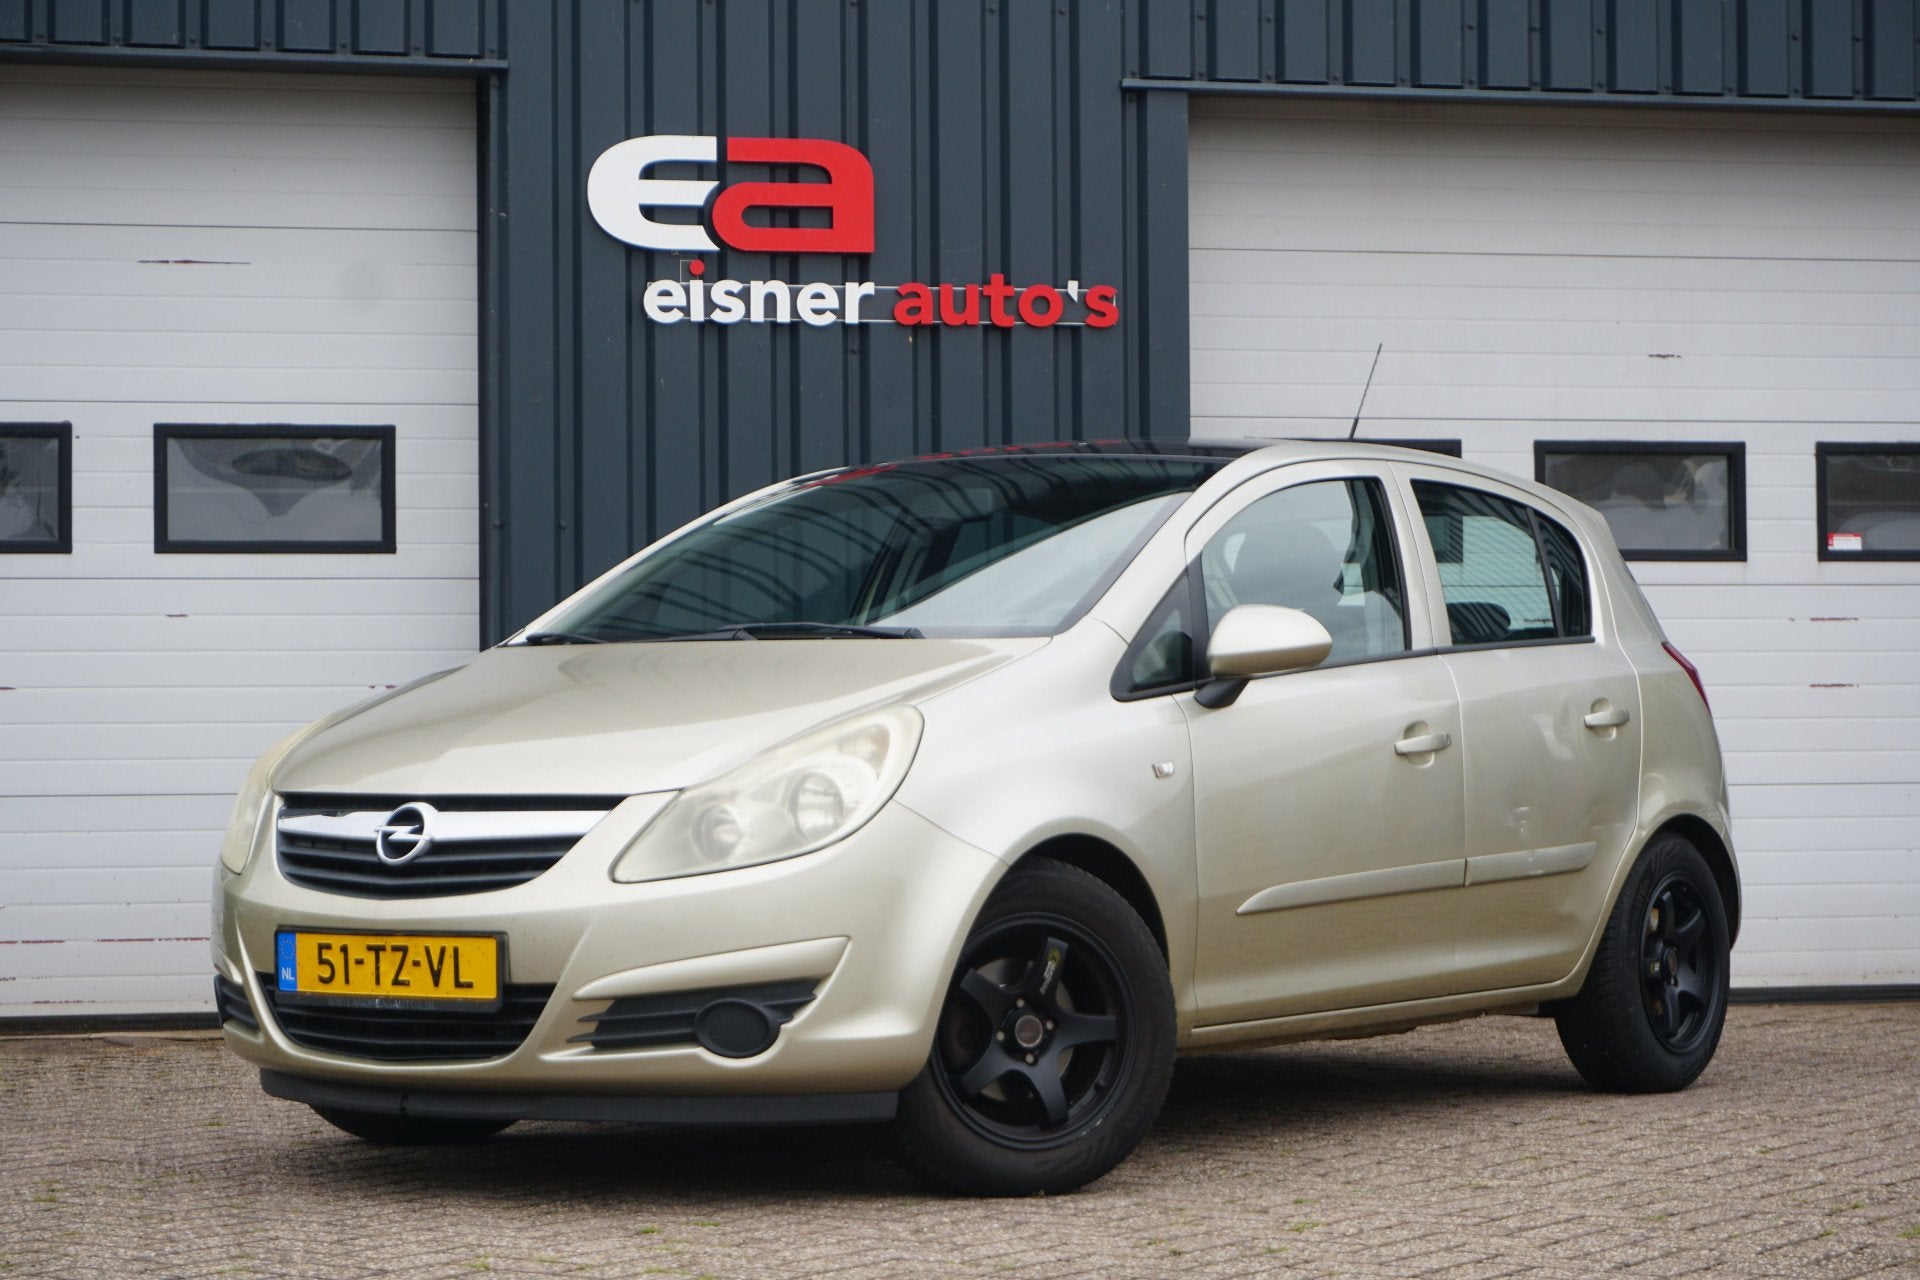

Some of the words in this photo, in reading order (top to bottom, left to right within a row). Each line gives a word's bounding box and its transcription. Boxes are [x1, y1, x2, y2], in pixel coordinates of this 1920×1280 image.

[643, 259, 875, 325] eisner
[893, 273, 1120, 328] auto's
[281, 966, 295, 980] NL
[317, 942, 474, 989] 51-TZ-VL
